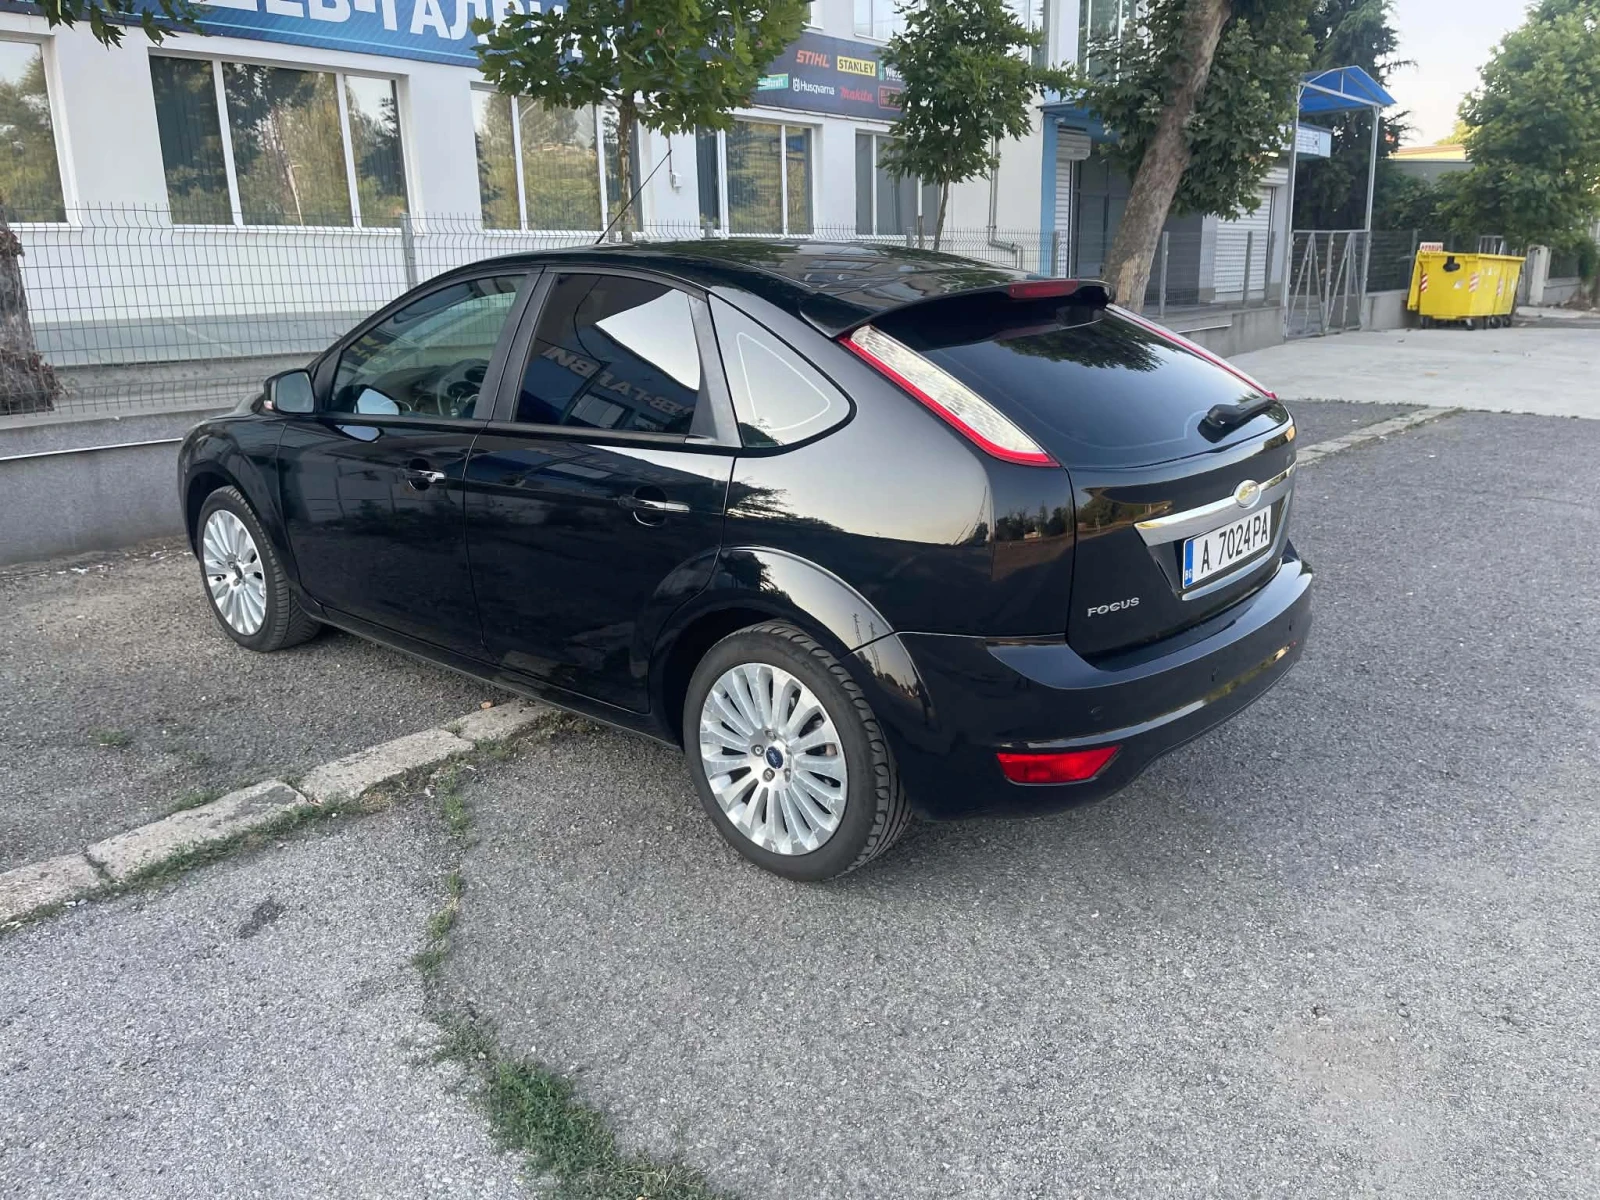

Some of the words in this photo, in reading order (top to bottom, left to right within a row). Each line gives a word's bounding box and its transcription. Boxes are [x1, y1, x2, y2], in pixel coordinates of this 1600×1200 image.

[796, 50, 830, 68] STIHL
[838, 59, 874, 74] STANLEY
[800, 80, 835, 95] Husqvarna
[1201, 539, 1210, 573] A
[1087, 597, 1140, 617] FOCUS
